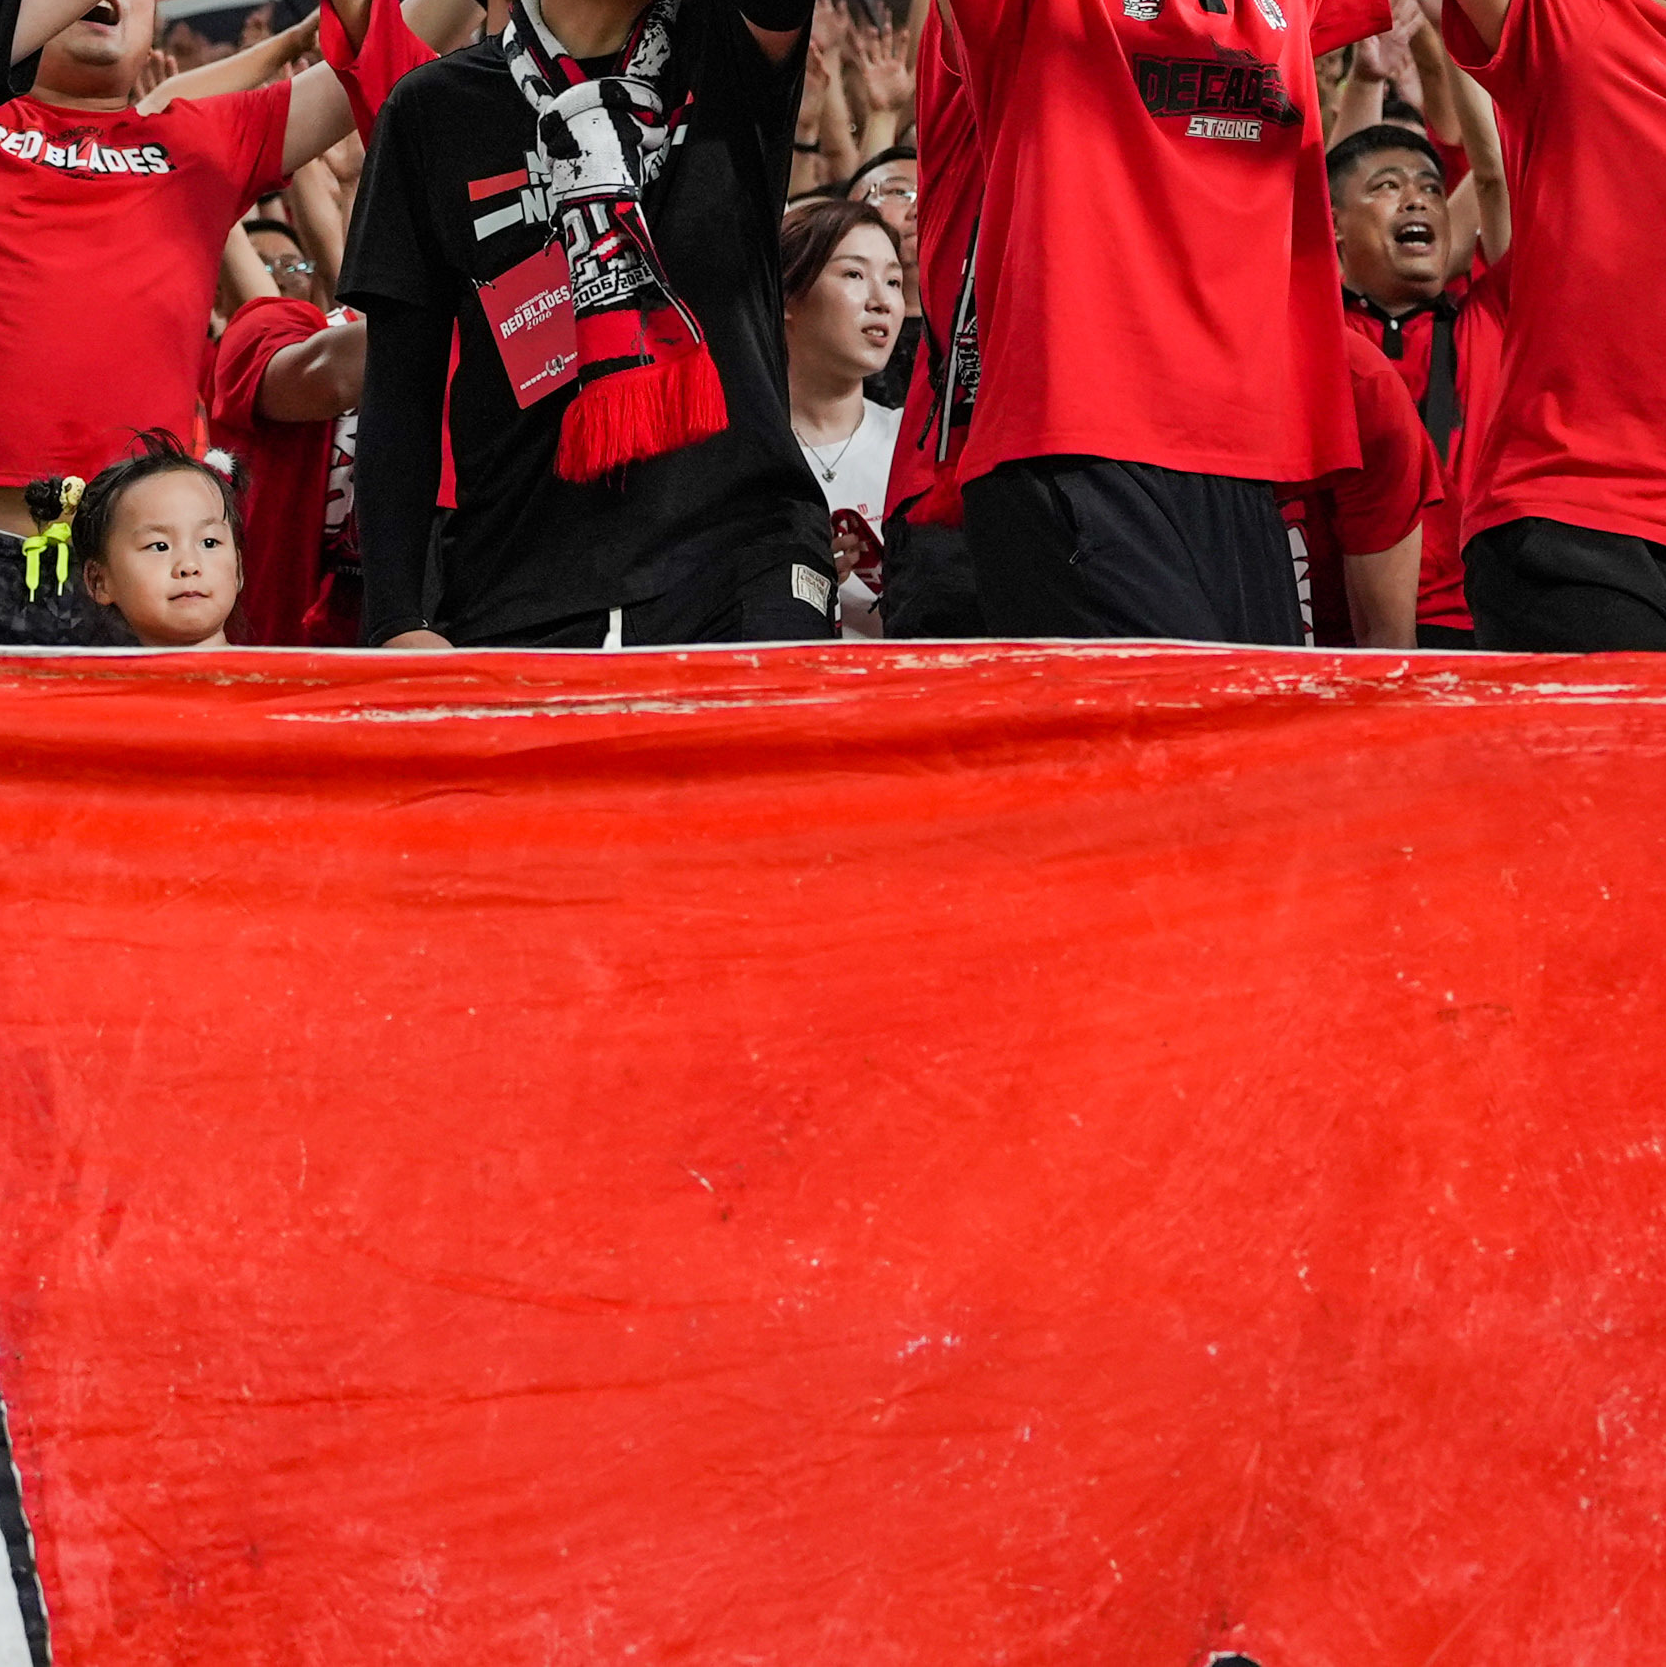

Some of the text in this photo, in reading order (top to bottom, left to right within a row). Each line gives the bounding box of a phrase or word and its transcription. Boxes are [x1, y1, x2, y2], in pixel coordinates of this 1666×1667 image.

[1186, 116, 1263, 141] STRONG
[44, 140, 171, 174] BLADES
[499, 285, 571, 340] RED BLADES
